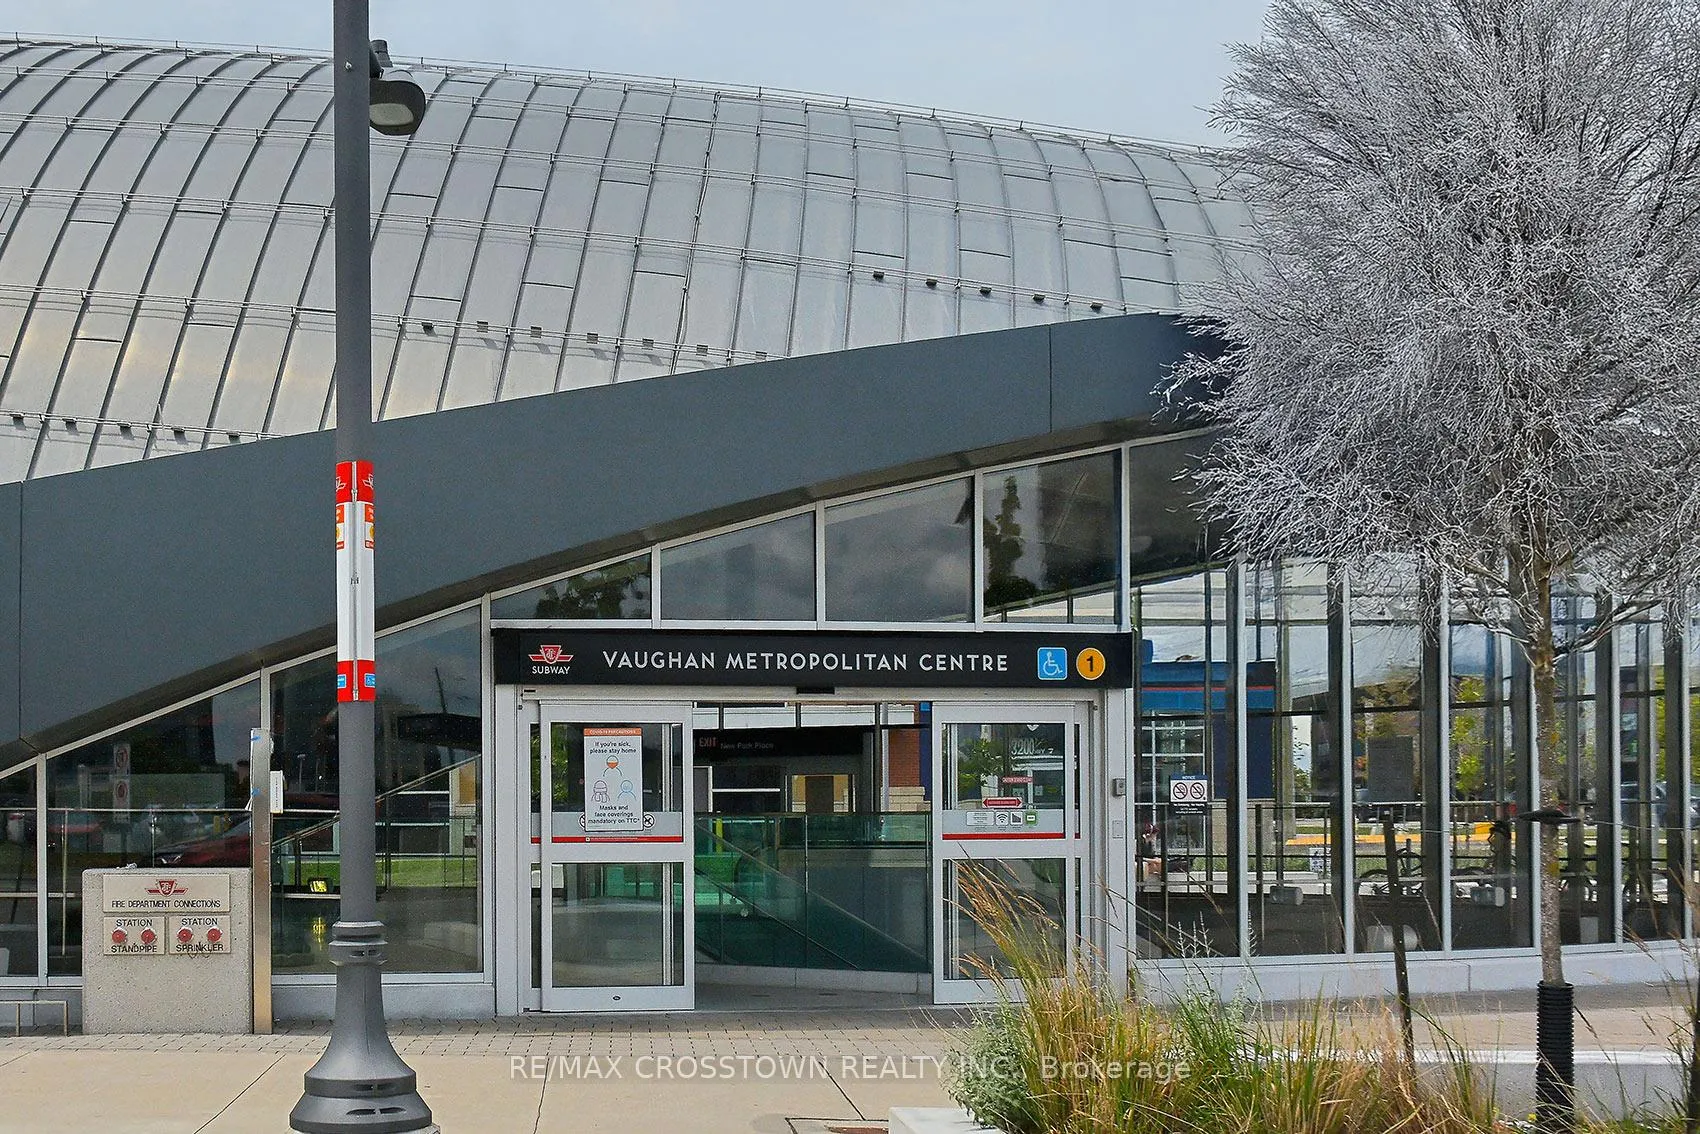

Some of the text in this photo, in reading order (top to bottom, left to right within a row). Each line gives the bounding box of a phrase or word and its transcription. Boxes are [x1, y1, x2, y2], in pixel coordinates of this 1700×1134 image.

[602, 650, 1008, 672] VAUGHAN METROPOLITAN CENTRE
[1086, 655, 1094, 672] 1
[531, 665, 571, 674] SUBWAY
[699, 737, 717, 747] EXIT
[112, 900, 221, 908] FIRE DEPARTMENT CONNECTIONS
[116, 919, 153, 927] STATION
[181, 918, 218, 926] STATION
[111, 945, 157, 953] STANDPIPE
[176, 943, 224, 952] SPRINKLER
